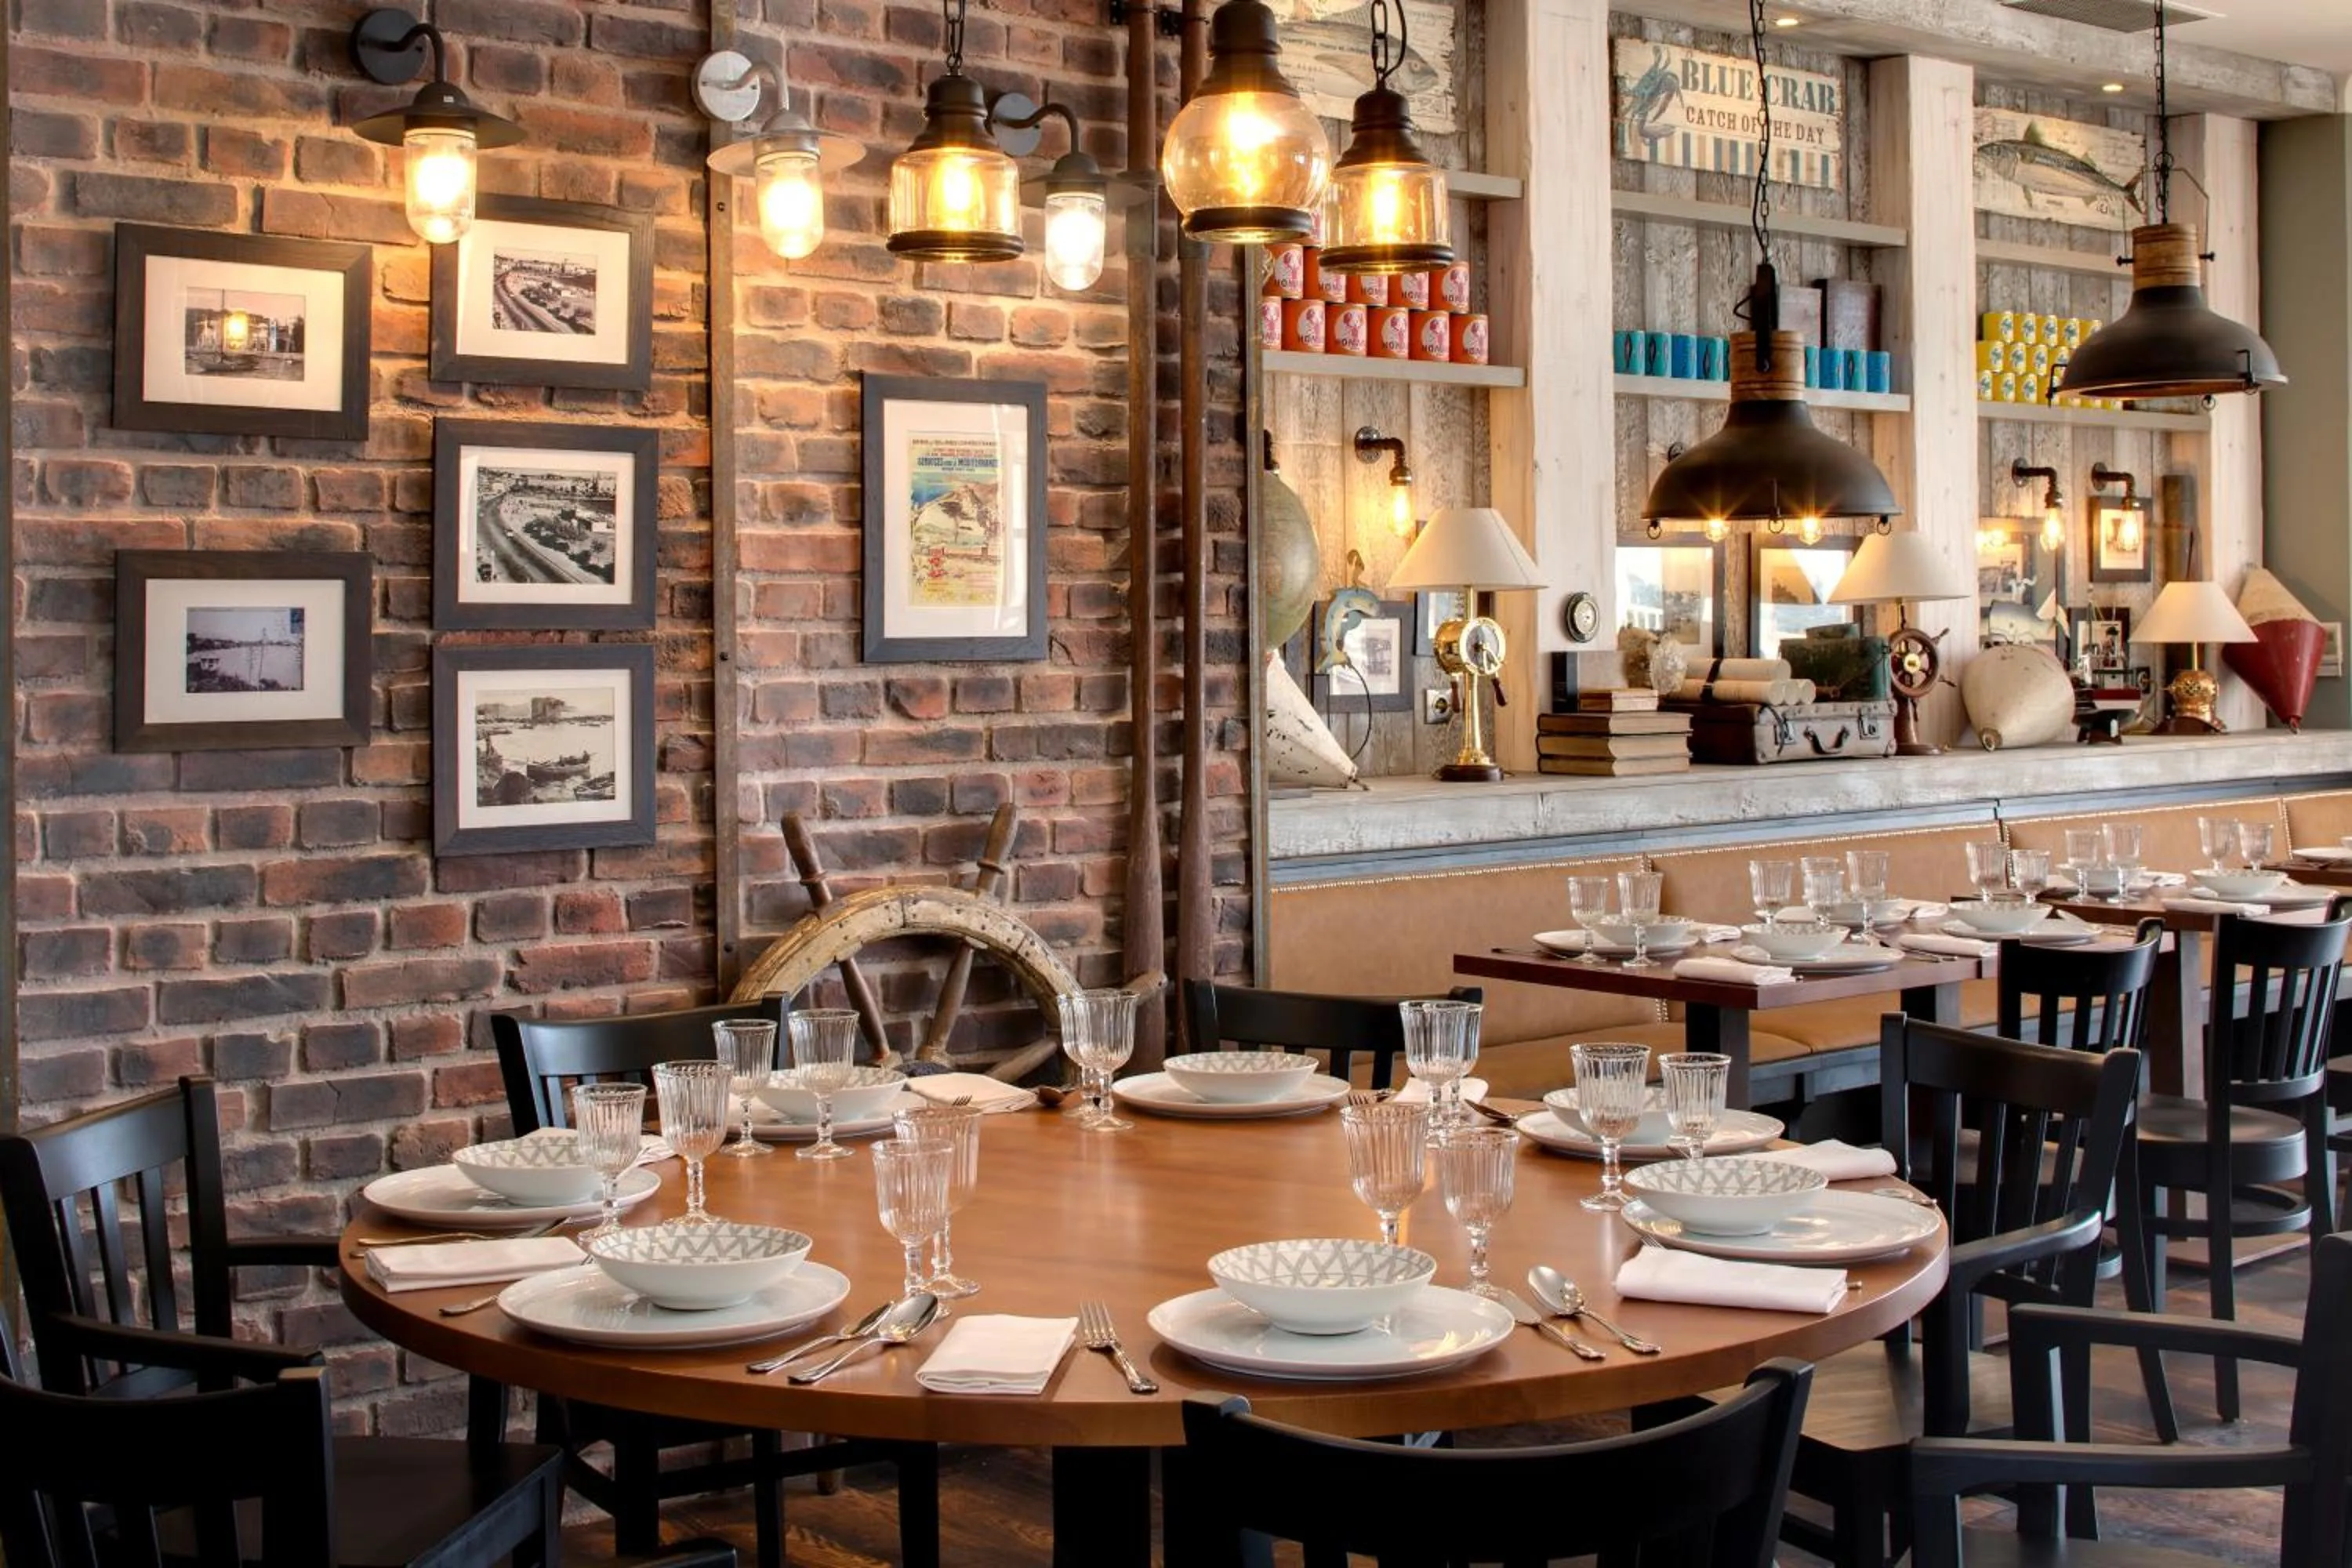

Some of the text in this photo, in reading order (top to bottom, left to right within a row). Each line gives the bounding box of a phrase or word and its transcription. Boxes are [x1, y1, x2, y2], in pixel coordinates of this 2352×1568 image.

[1681, 59, 1837, 116] BLUE CRAB
[1686, 106, 1824, 144] CATCH OF HE DAY
